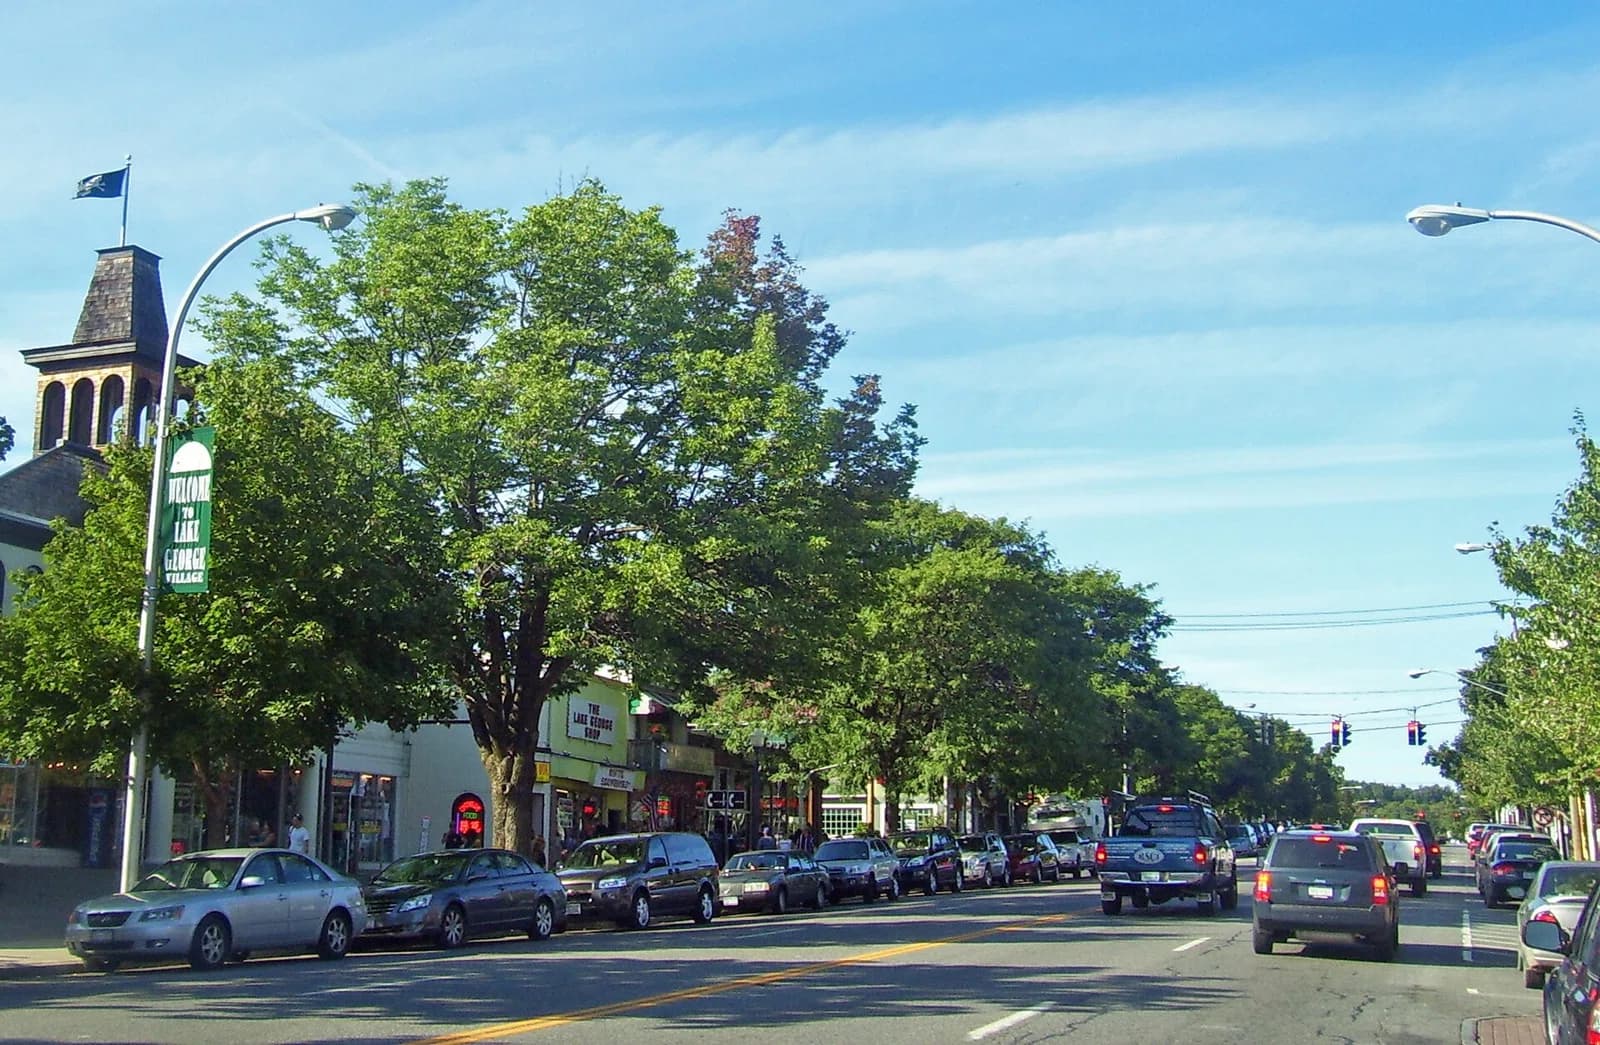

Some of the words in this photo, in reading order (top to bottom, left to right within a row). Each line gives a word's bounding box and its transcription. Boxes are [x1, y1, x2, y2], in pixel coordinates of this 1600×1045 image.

[168, 474, 211, 504] WELCOME
[182, 507, 194, 519] TO
[174, 519, 200, 543] LAKE
[164, 547, 206, 571] GEORGE
[166, 572, 204, 584] VILLAGE
[588, 703, 600, 715] THE
[573, 712, 588, 725] LAKE
[590, 716, 613, 731] GEORGE
[585, 727, 600, 740] SHOP
